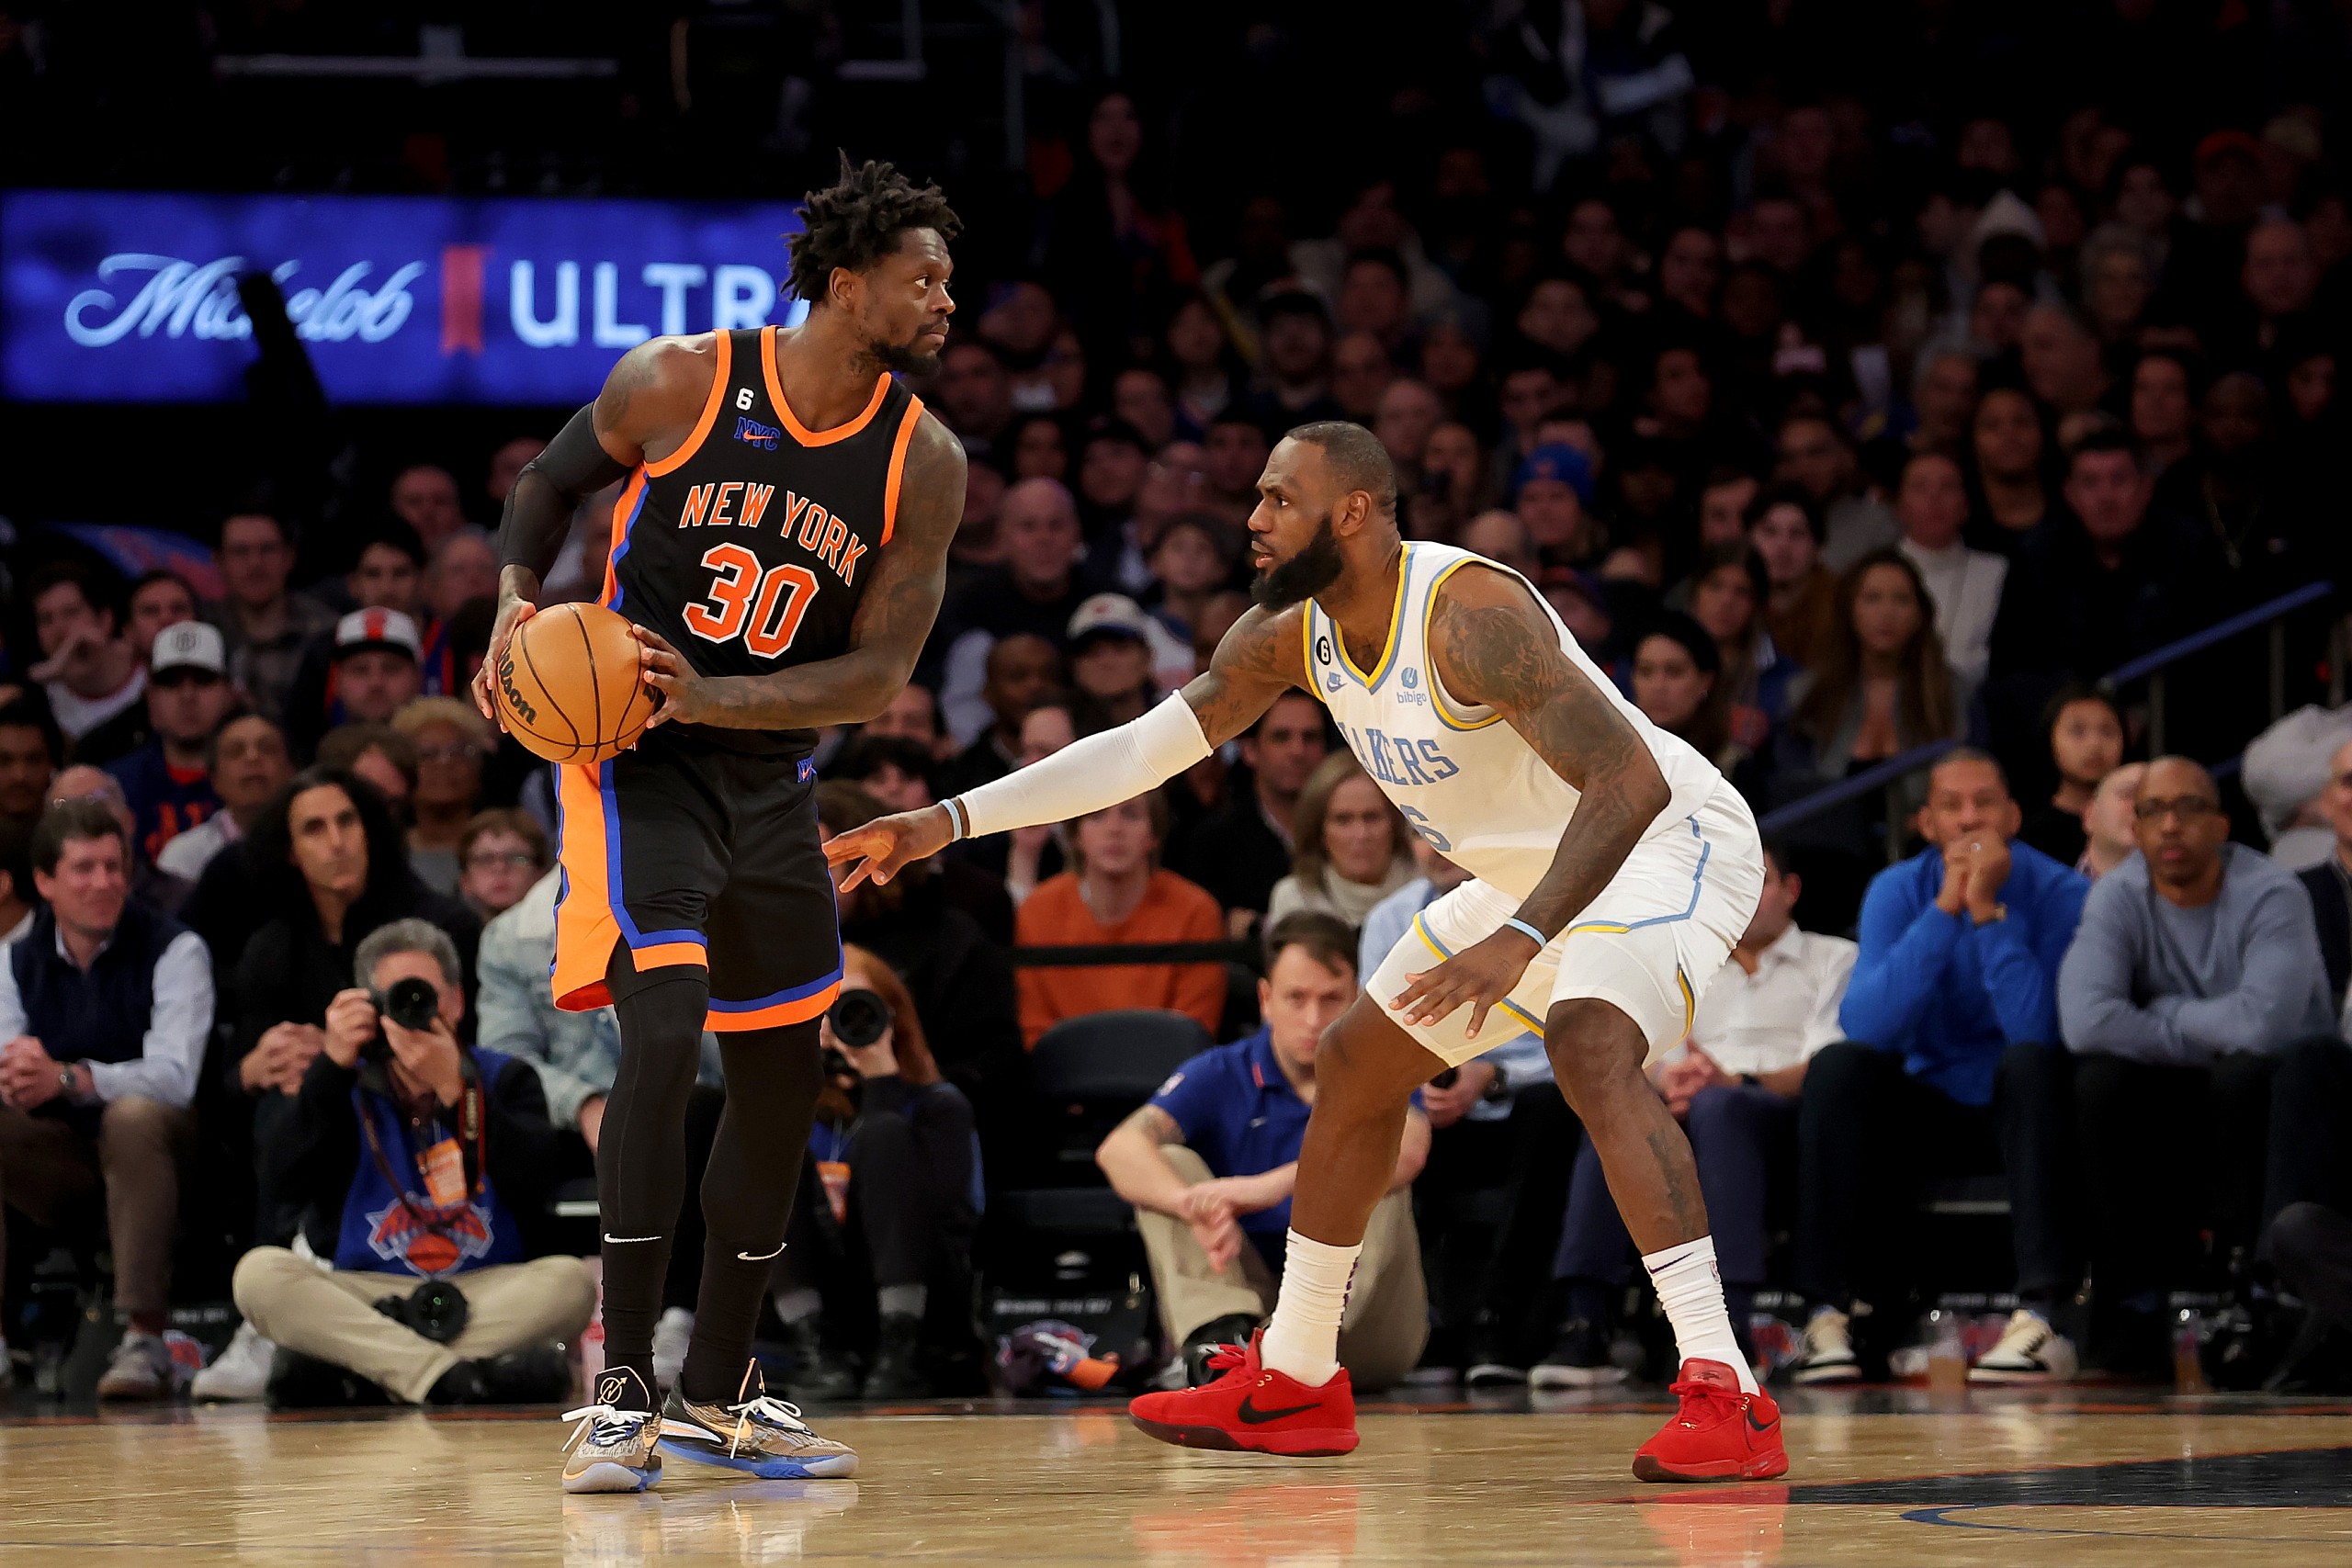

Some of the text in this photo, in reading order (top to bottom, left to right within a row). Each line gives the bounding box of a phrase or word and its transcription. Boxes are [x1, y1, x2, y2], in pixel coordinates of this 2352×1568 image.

[735, 387, 755, 412] 6
[733, 416, 781, 451] NYC
[678, 481, 868, 588] NEW YORK
[682, 542, 820, 660] 30
[1319, 639, 1330, 663] 6
[1396, 691, 1428, 706] bibigo
